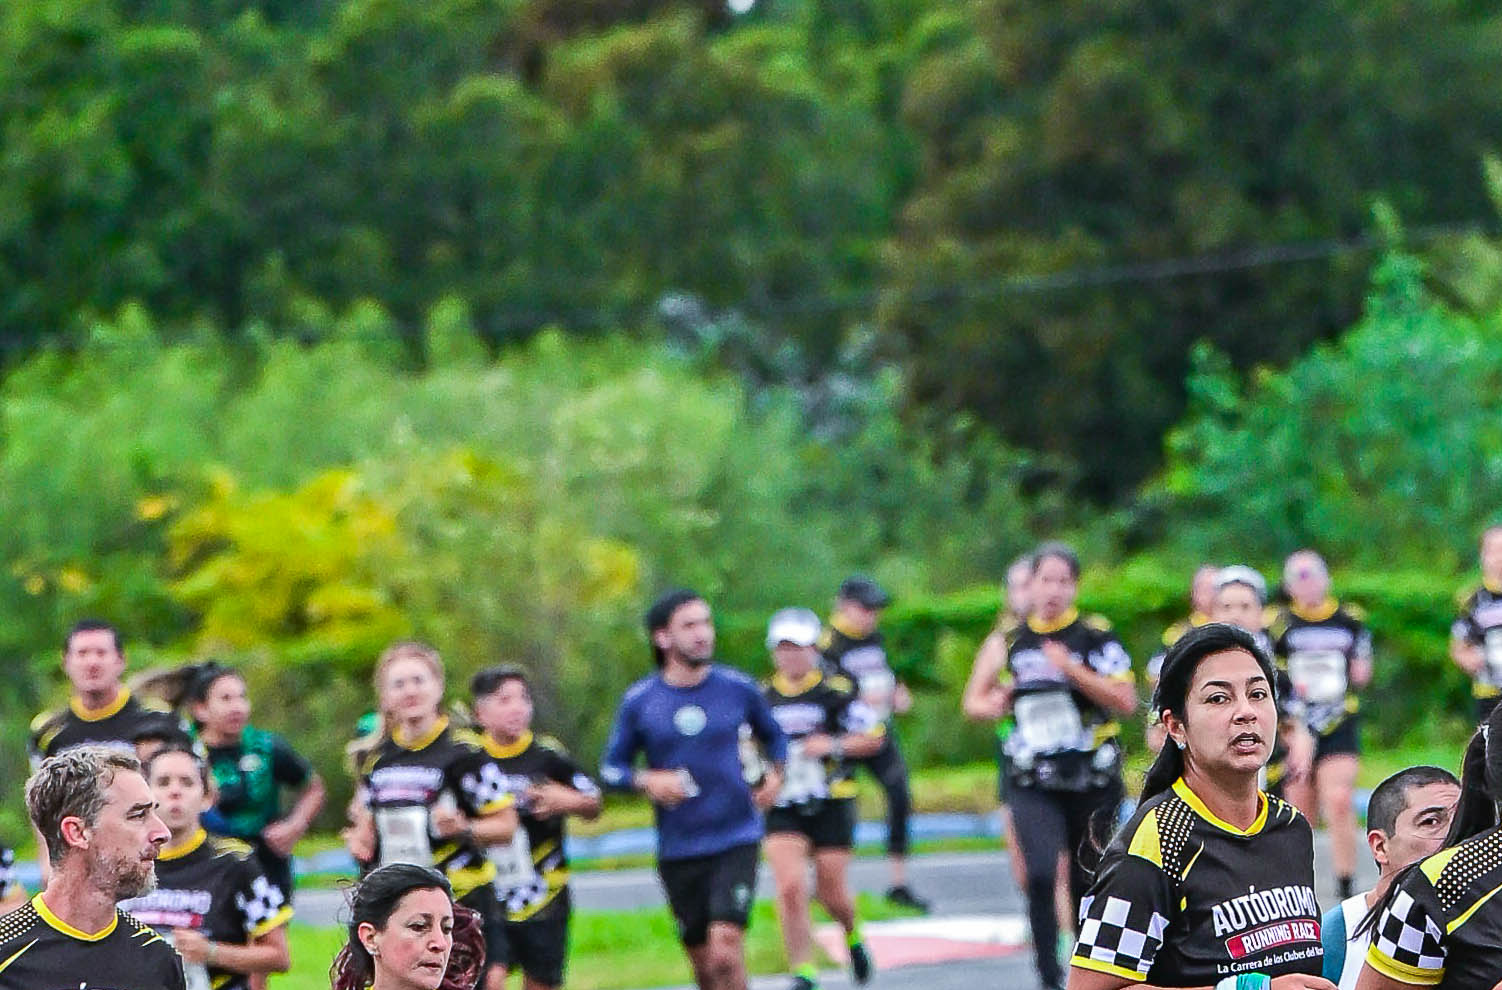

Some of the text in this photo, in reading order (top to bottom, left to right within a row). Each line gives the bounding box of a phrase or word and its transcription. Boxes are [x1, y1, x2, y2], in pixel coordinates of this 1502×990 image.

[1211, 885, 1317, 937] AUTÓDROMO
[1241, 921, 1317, 954] RUNNING RACE
[1217, 964, 1229, 974] La
[1230, 960, 1262, 972] Carrera
[1263, 956, 1273, 966] de
[1273, 954, 1283, 964] los
[1284, 950, 1305, 961] Clubes
